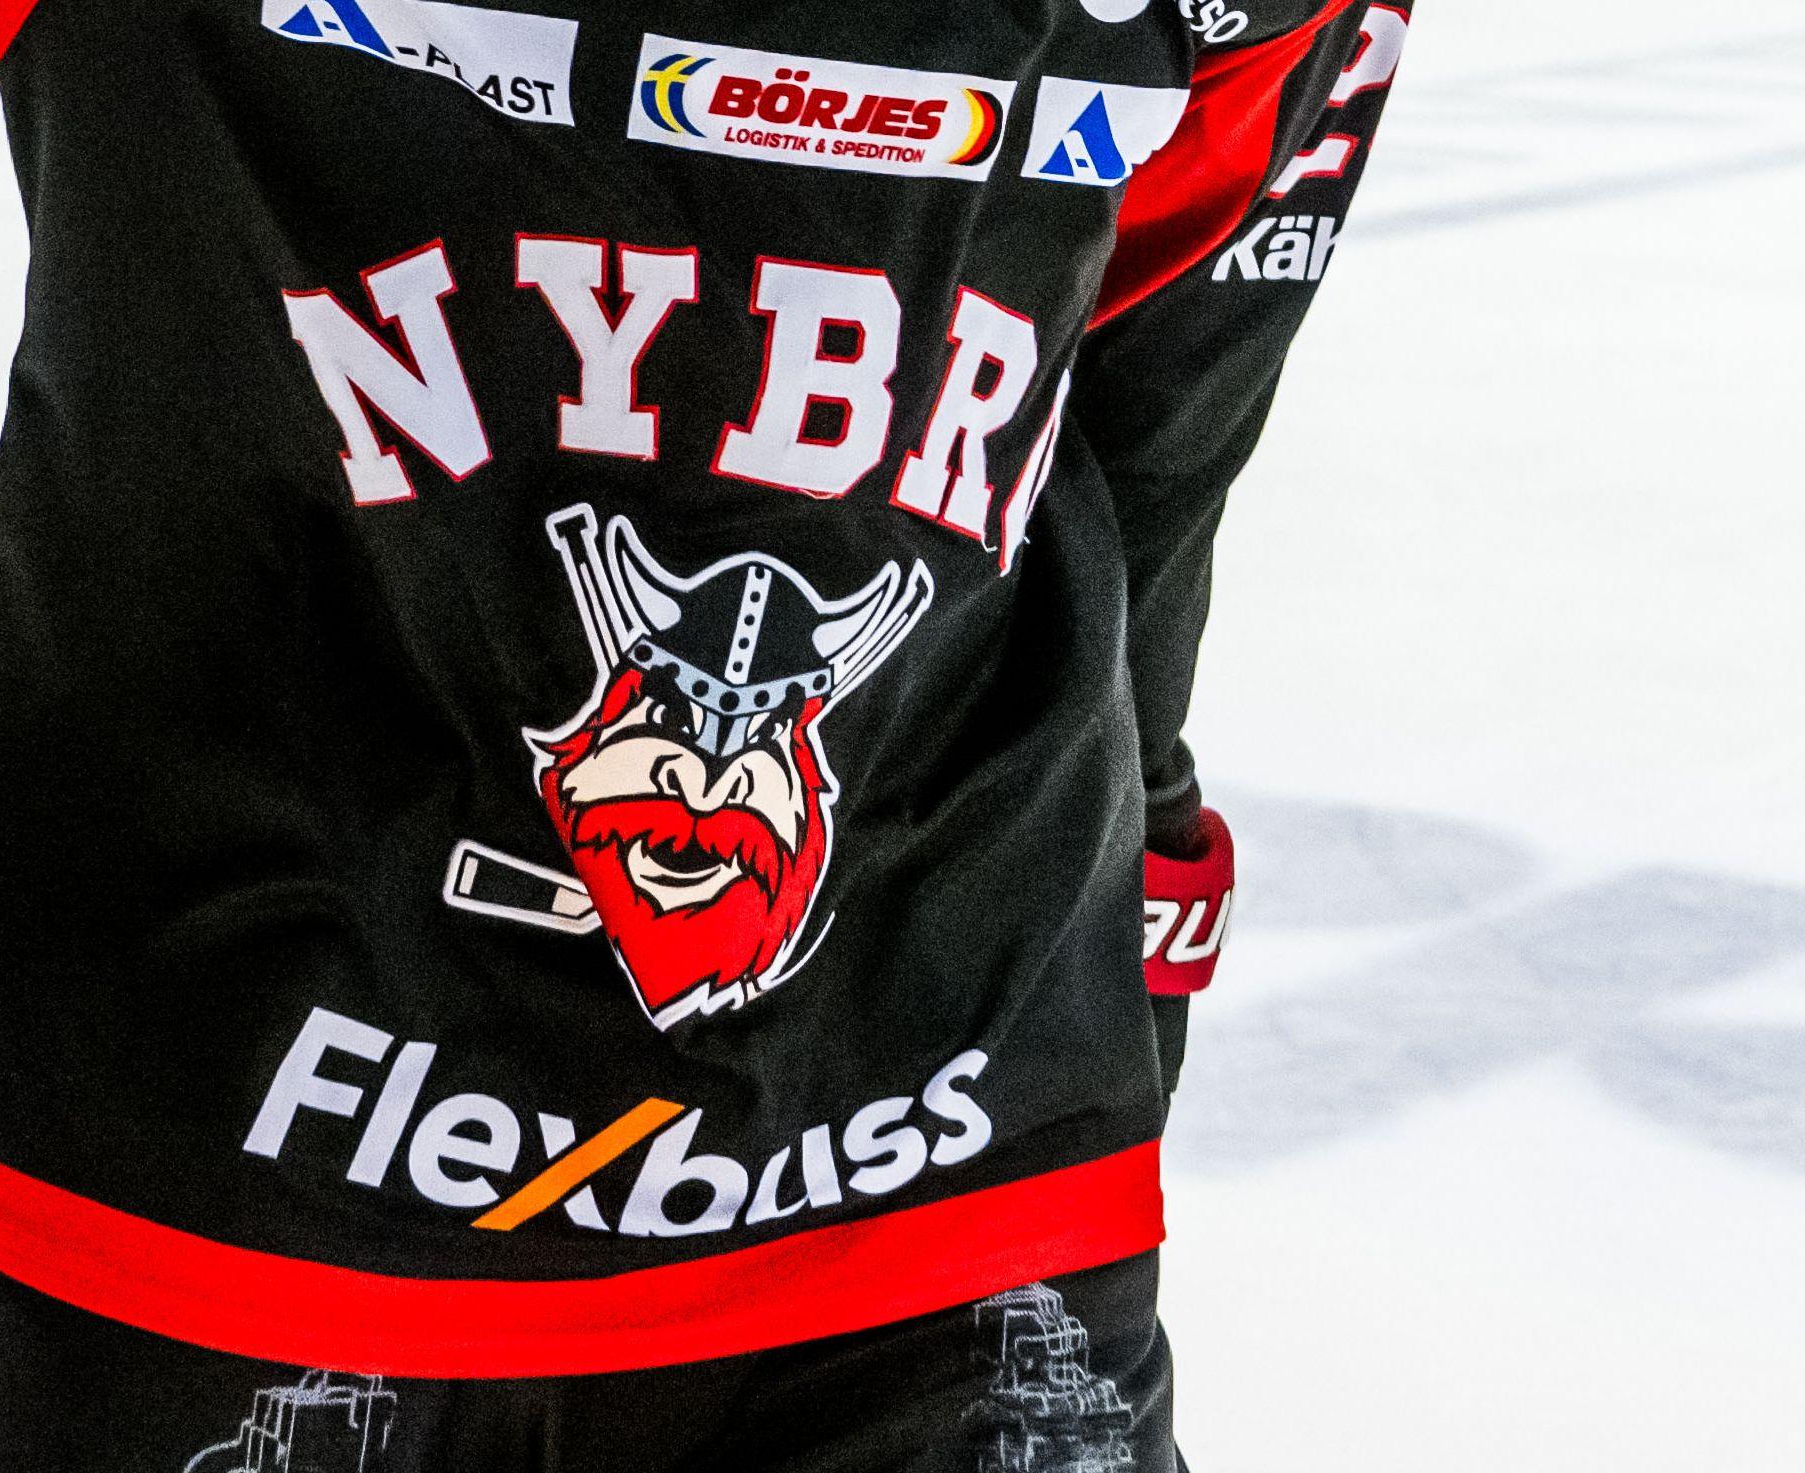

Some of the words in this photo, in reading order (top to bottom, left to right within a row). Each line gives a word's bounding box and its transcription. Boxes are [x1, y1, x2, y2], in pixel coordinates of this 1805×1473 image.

[708, 68, 948, 140] BÖRJES
[724, 127, 810, 152] LOGISTIK
[815, 138, 826, 154] &
[831, 140, 926, 164] SPEDITION
[280, 231, 1072, 576] NYBR
[243, 1006, 992, 1238] Flexbuss
